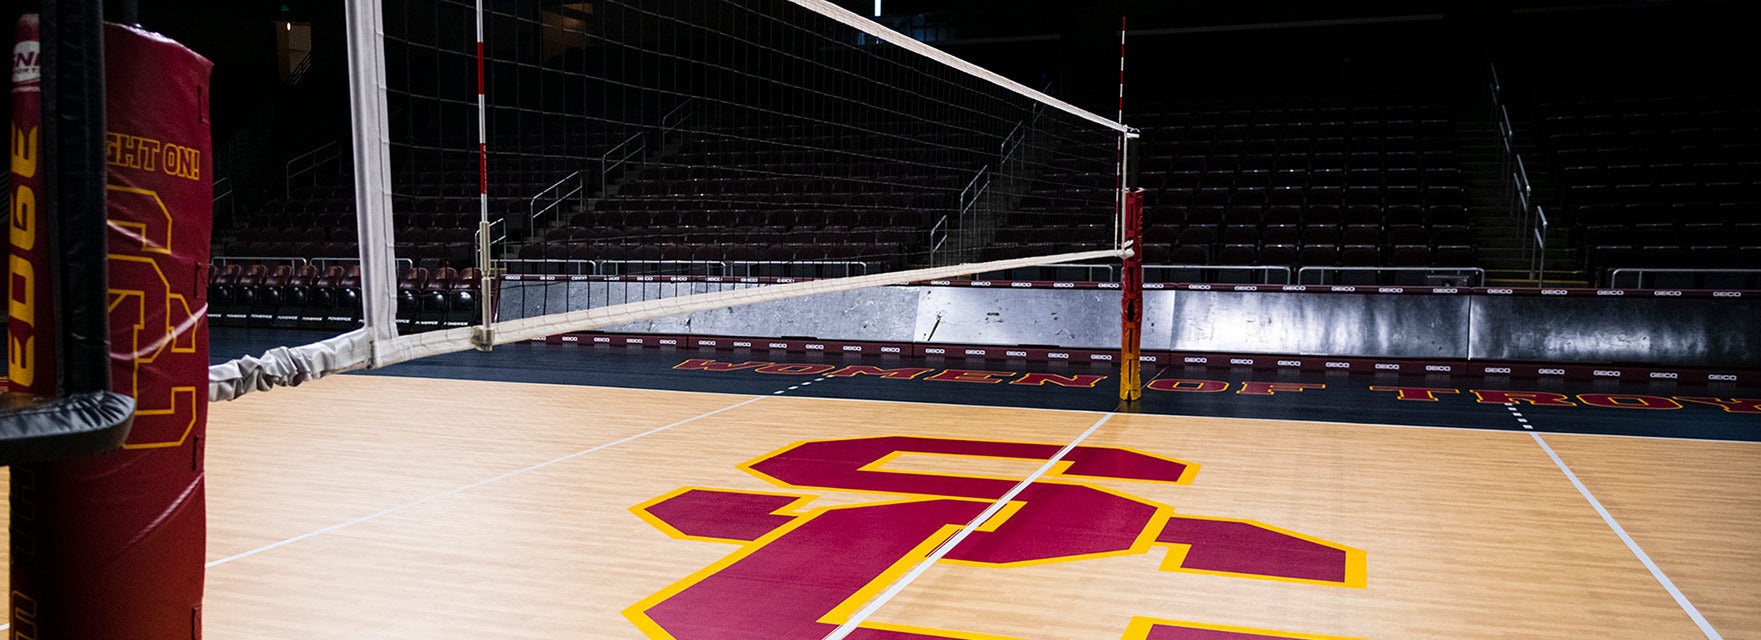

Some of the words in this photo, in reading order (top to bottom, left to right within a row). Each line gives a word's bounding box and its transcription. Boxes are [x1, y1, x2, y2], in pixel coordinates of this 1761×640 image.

[106, 131, 161, 172] GHT
[163, 142, 201, 181] ON!
[8, 120, 38, 388] EDGE
[672, 358, 1107, 388] WOMEN
[1147, 379, 1327, 396] OF
[1368, 386, 1761, 414] TROY
